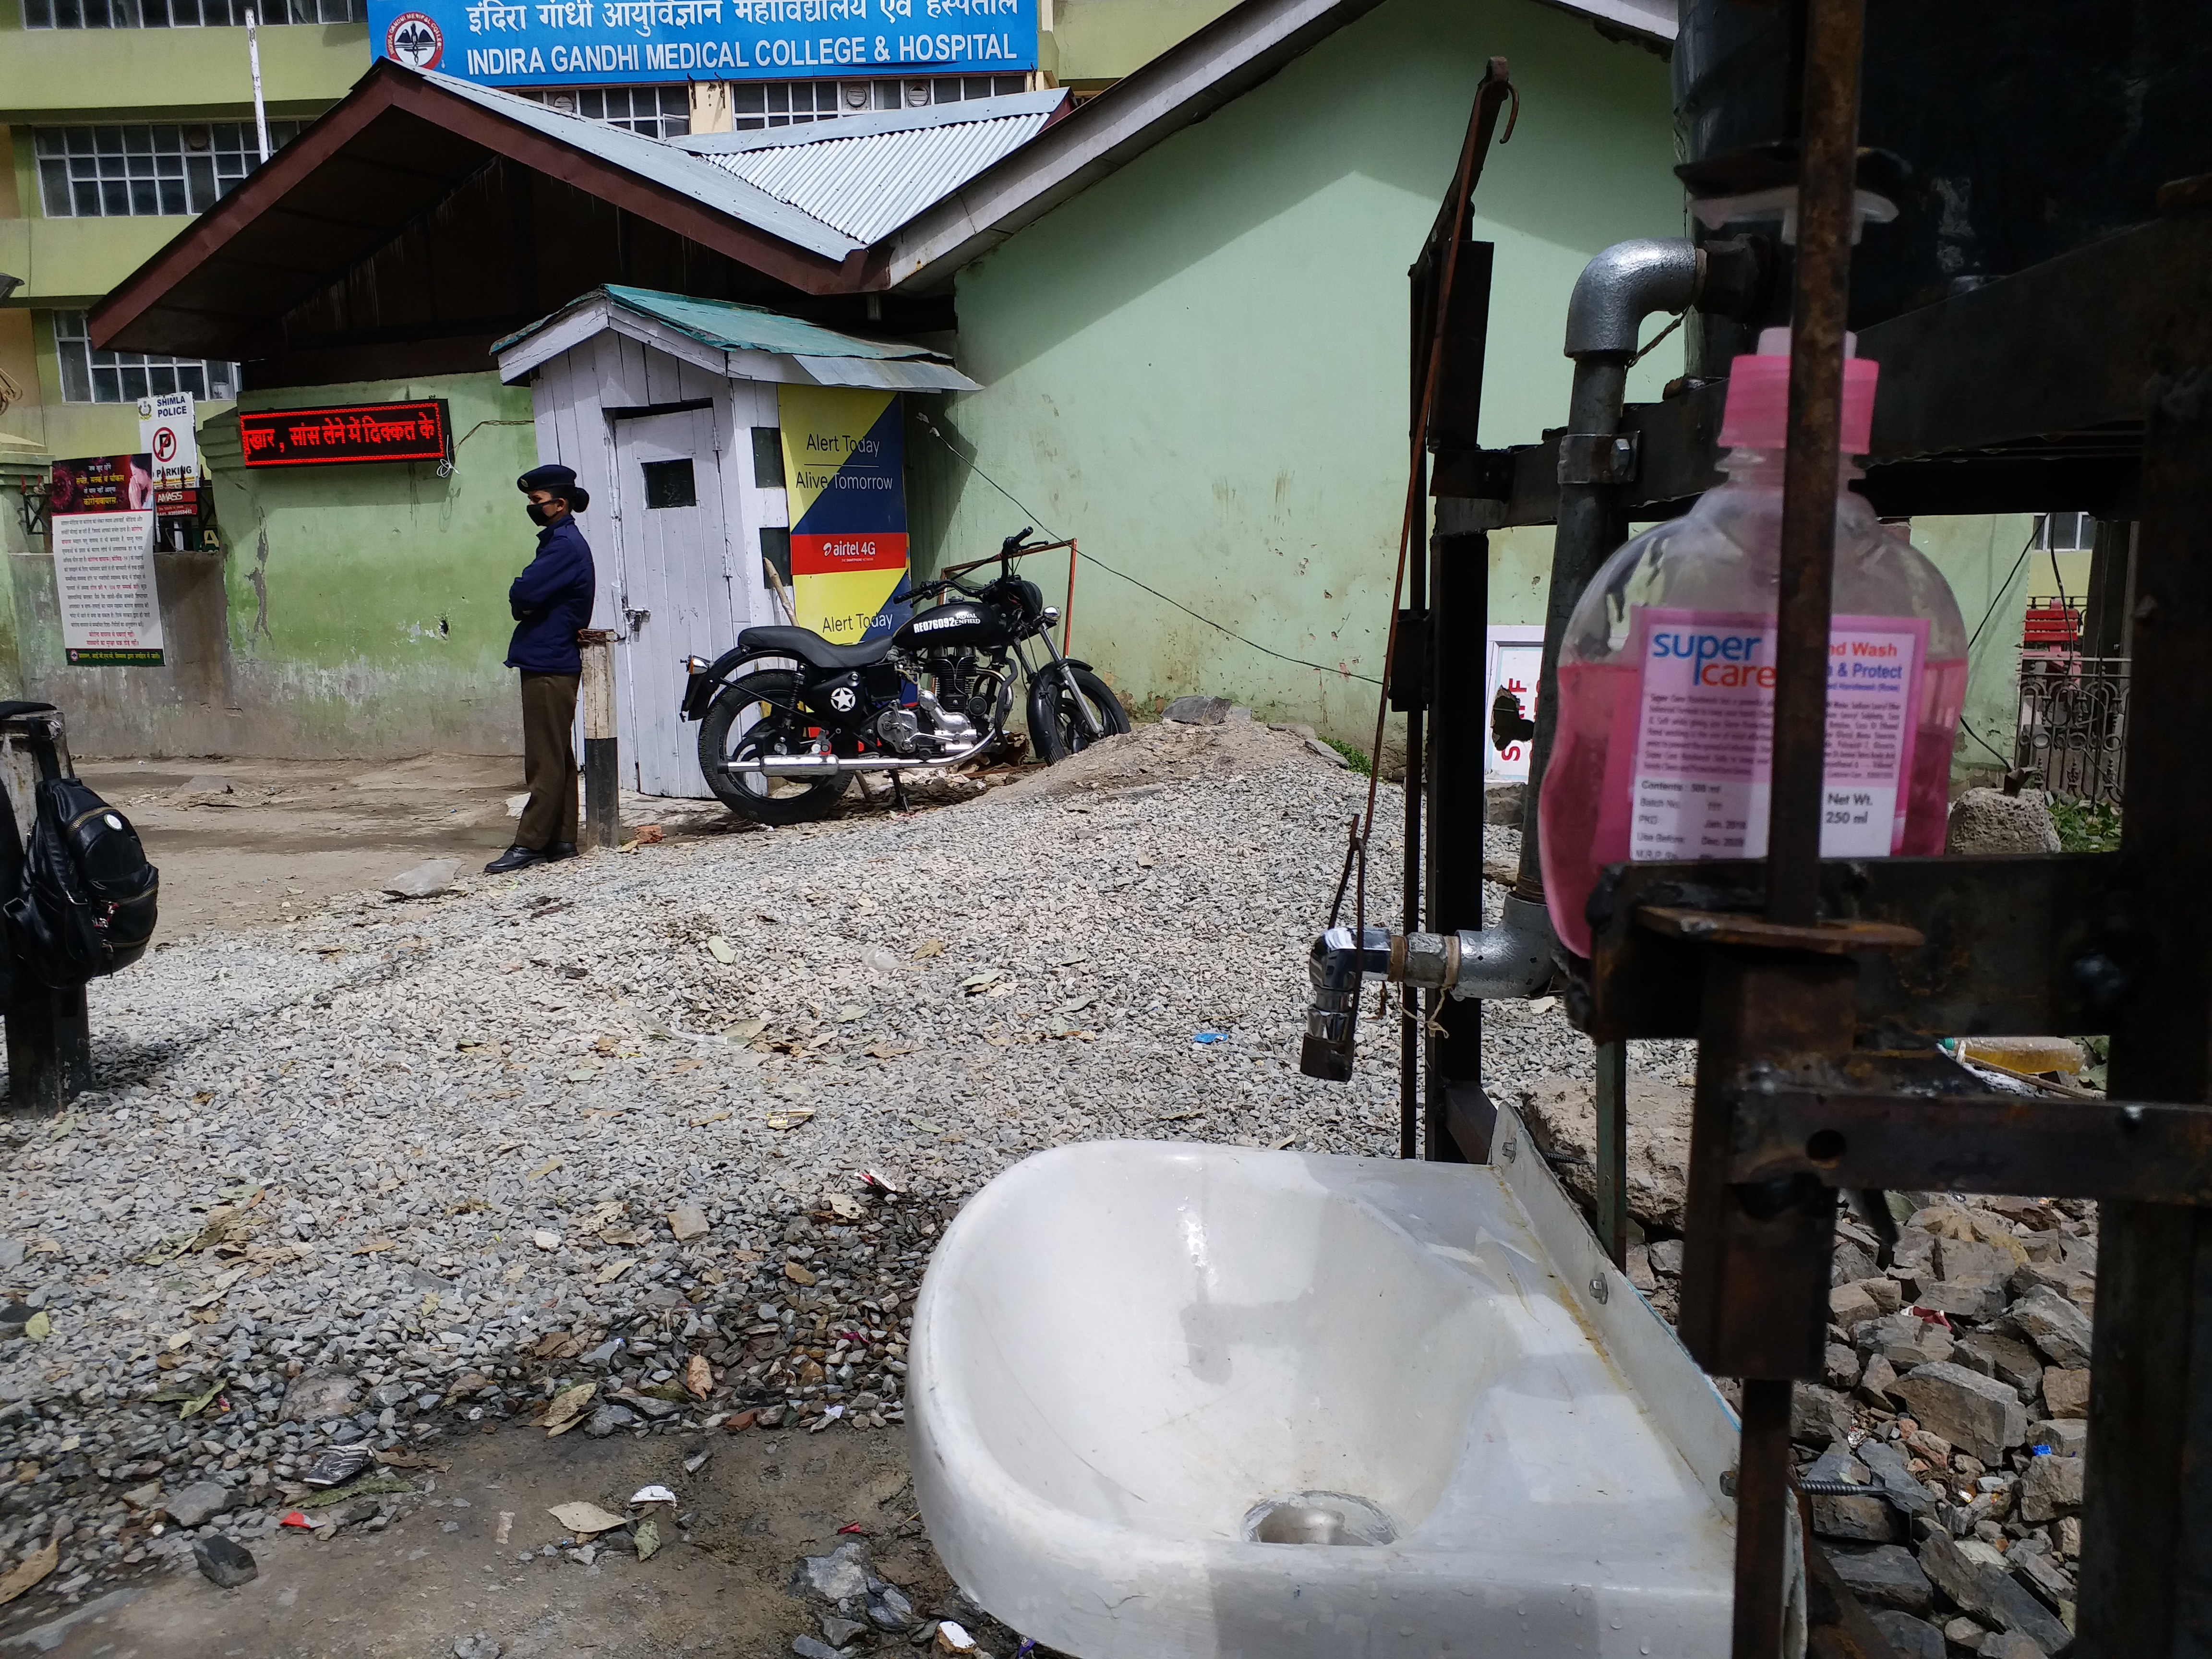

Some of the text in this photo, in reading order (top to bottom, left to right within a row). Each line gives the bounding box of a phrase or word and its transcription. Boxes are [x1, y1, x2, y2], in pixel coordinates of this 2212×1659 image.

[467, 33, 1017, 75] INDIRA GANDHI MEDICAL COLLEGE & HOSPITAL
[157, 396, 185, 407] SHIMLA
[157, 406, 187, 418] POLICE
[289, 422, 320, 445] सांस
[322, 417, 346, 444] लेने
[347, 416, 361, 443] में
[362, 415, 415, 443] दिक्कत
[418, 412, 435, 440] के
[806, 433, 880, 457] Alert Today
[796, 471, 893, 490] Alive Tomorrow
[833, 540, 876, 556] airtel 4G
[822, 613, 893, 633] Alert Today
[1829, 641, 1897, 657] nd Wash
[1653, 633, 1762, 686] super
[1701, 664, 1776, 689] care
[1838, 662, 1848, 677] &
[1852, 662, 1903, 679] Protect
[1641, 780, 1683, 791] Contents
[1827, 793, 1873, 805] Net Wt.
[1826, 811, 1868, 824] 250 ml
